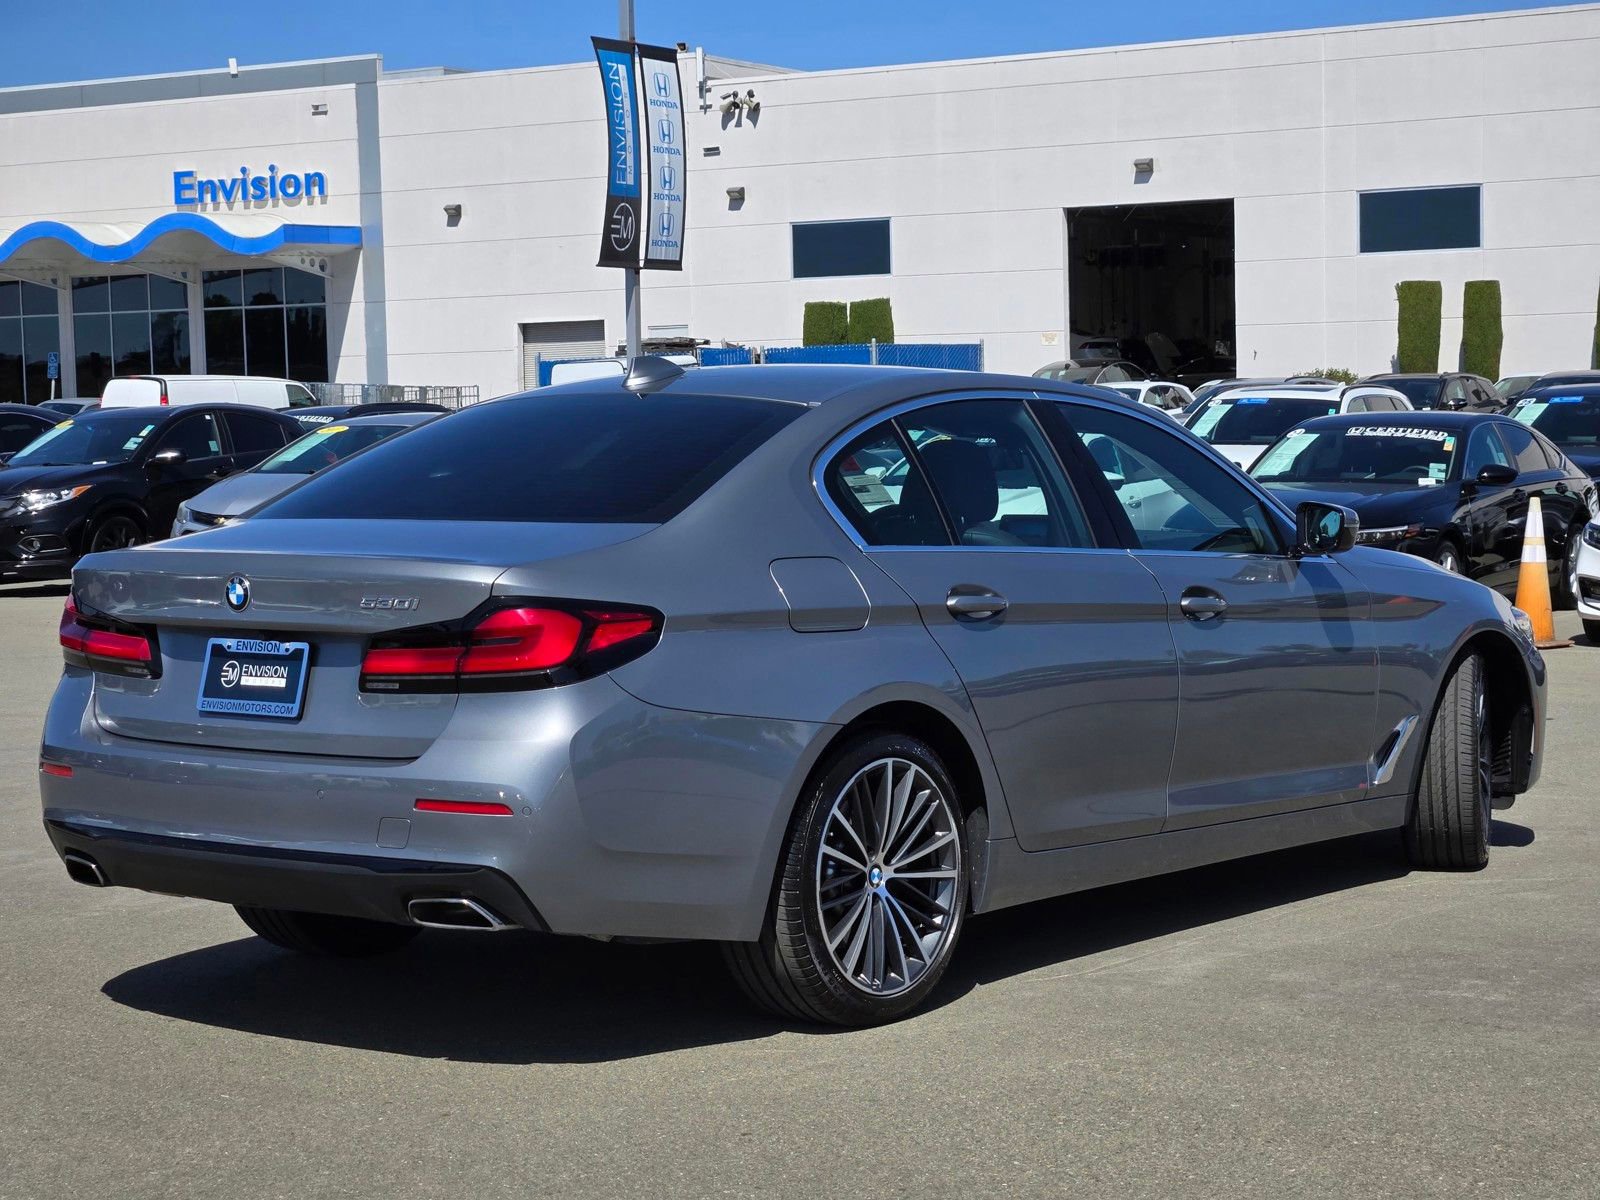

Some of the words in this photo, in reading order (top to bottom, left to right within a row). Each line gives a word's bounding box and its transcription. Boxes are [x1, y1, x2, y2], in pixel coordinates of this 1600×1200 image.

[649, 98, 678, 109] HONDA
[607, 62, 627, 185] ENVISION
[653, 146, 681, 156] HONDA
[173, 164, 325, 205] Envision
[653, 193, 681, 202] HONDA
[651, 240, 679, 248] HONDA
[1365, 427, 1449, 439] CERTIFIED
[235, 640, 281, 653] ENVISION
[241, 664, 288, 678] ENVISION
[201, 700, 293, 715] ENVISIONMOTORS.COM
